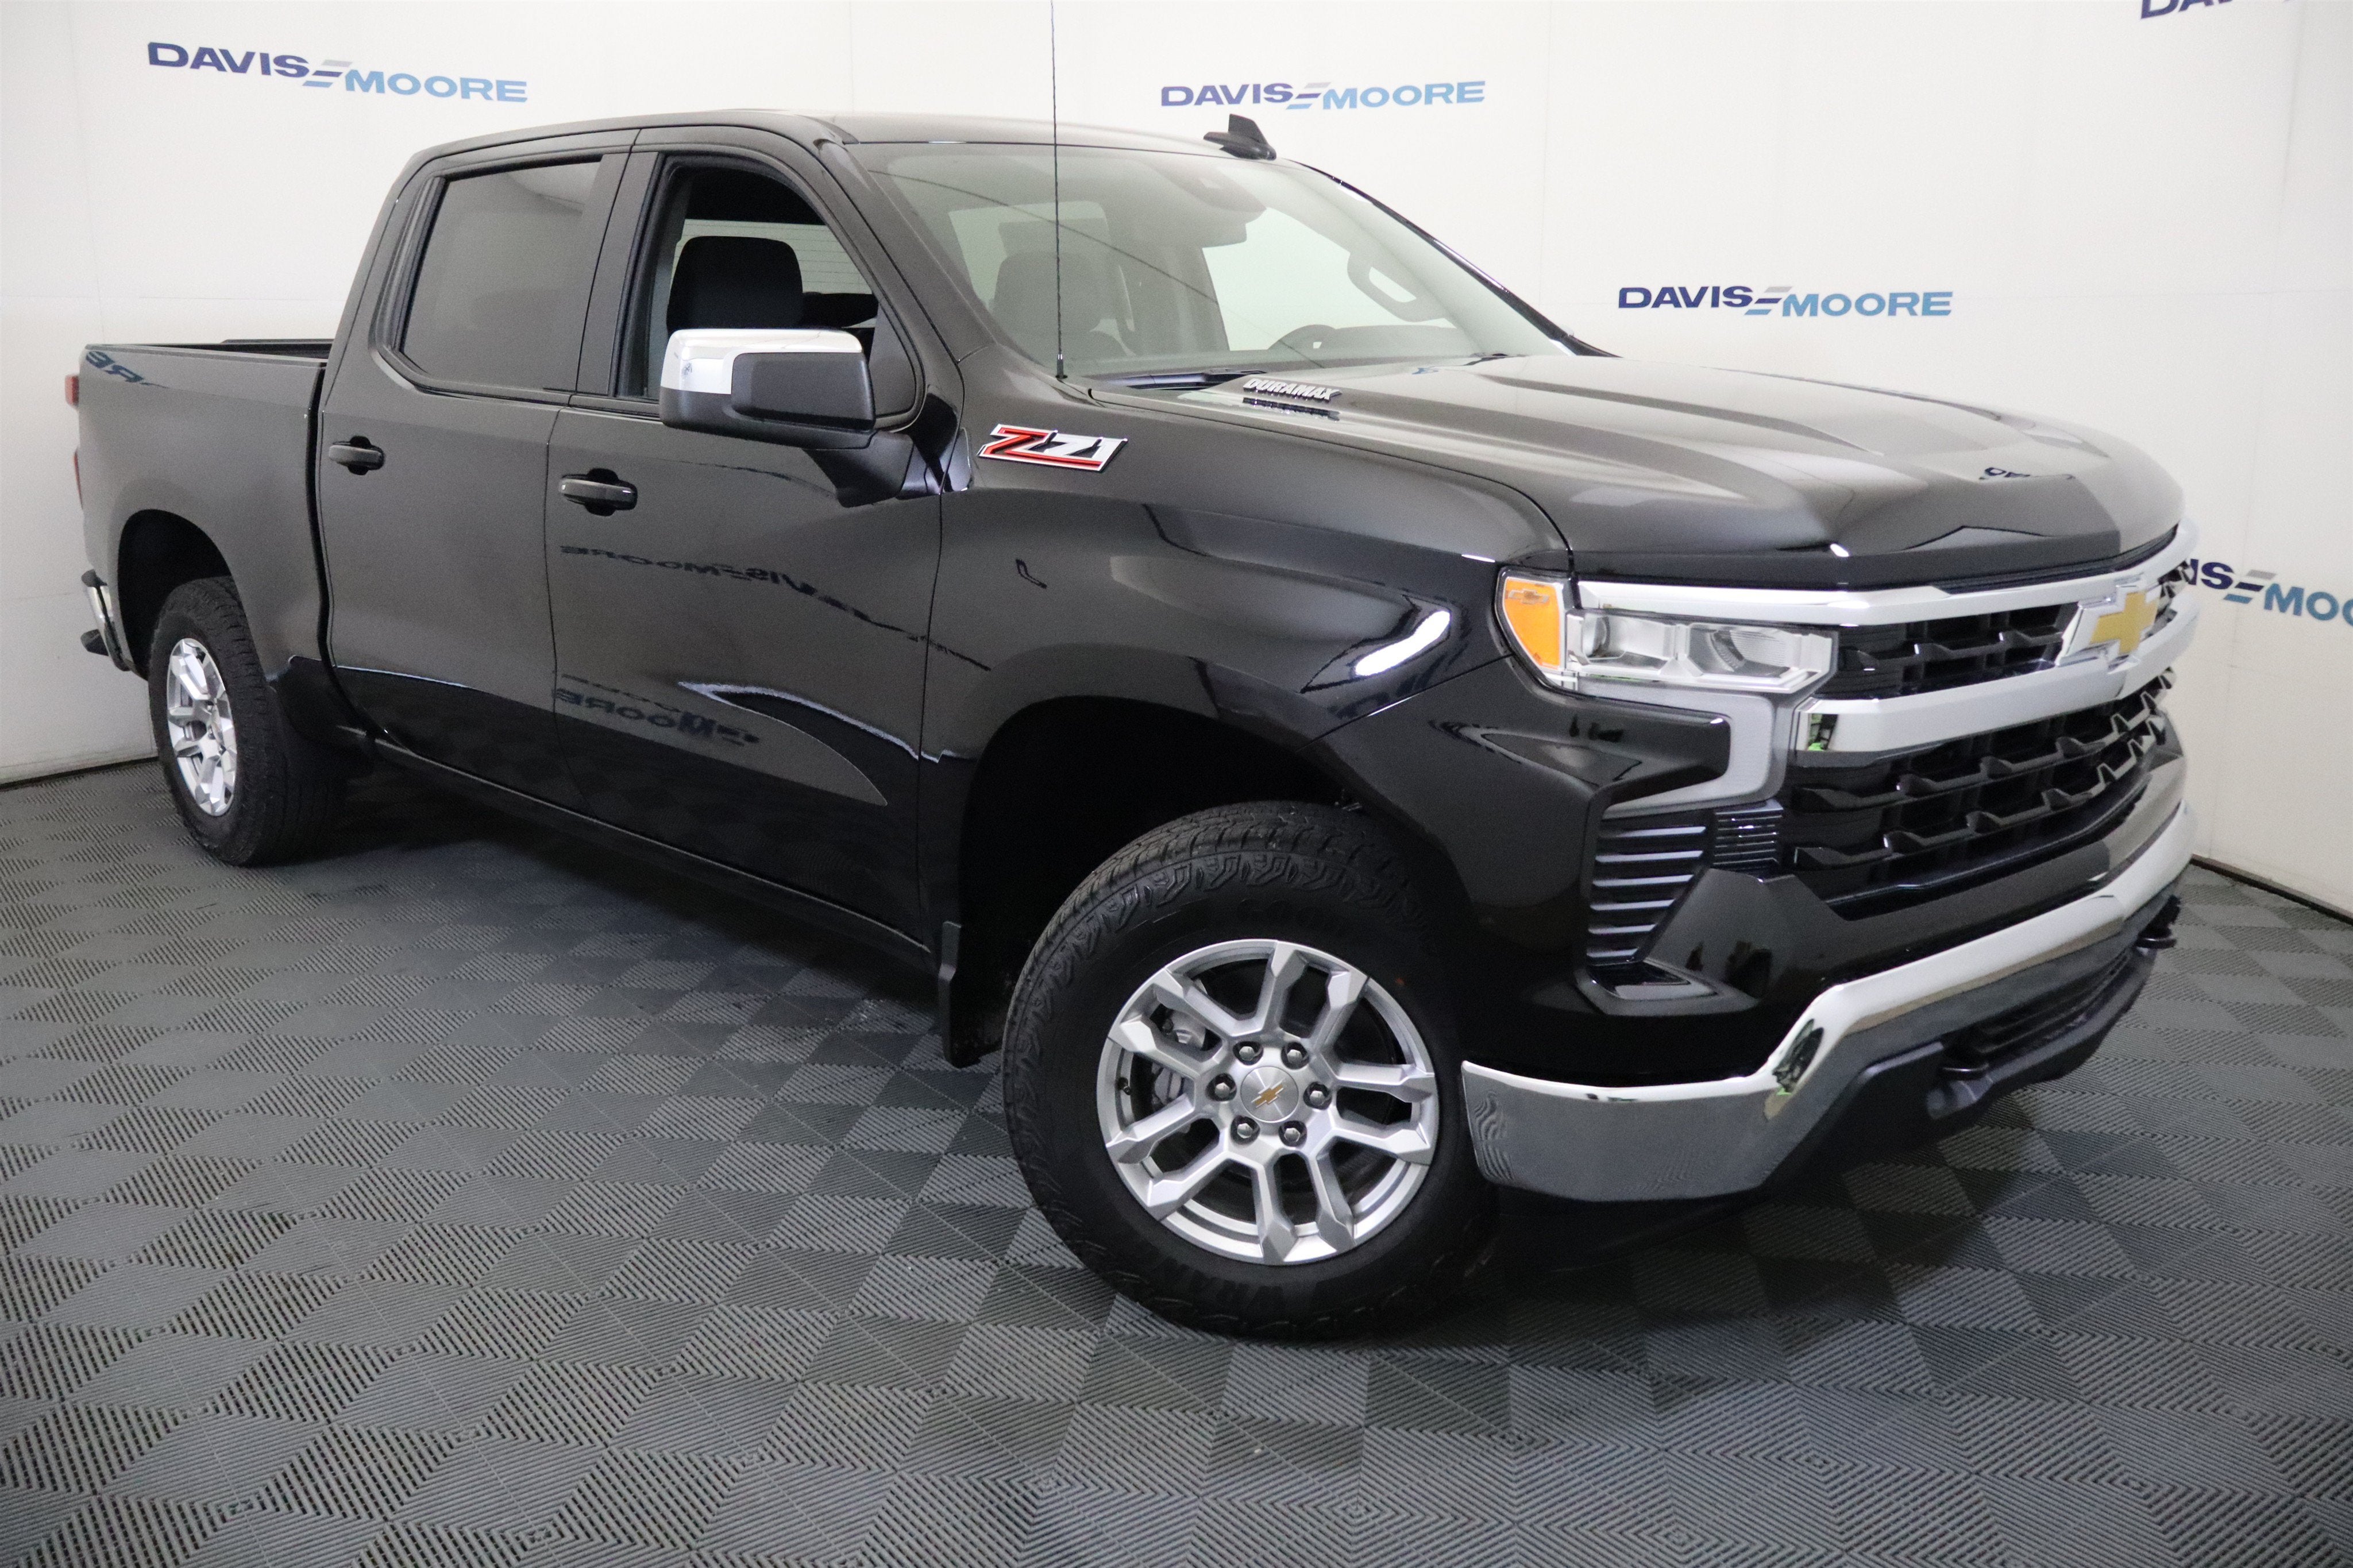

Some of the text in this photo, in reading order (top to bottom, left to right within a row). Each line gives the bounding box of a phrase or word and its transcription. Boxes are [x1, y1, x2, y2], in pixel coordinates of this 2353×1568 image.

[147, 41, 527, 103] DAVIS MOORE
[1160, 80, 1486, 110] DAVIS MOORE
[1618, 285, 1954, 317] DAVIS MOORE
[1243, 378, 1342, 401] DURAMAX
[977, 423, 1128, 472] Z71
